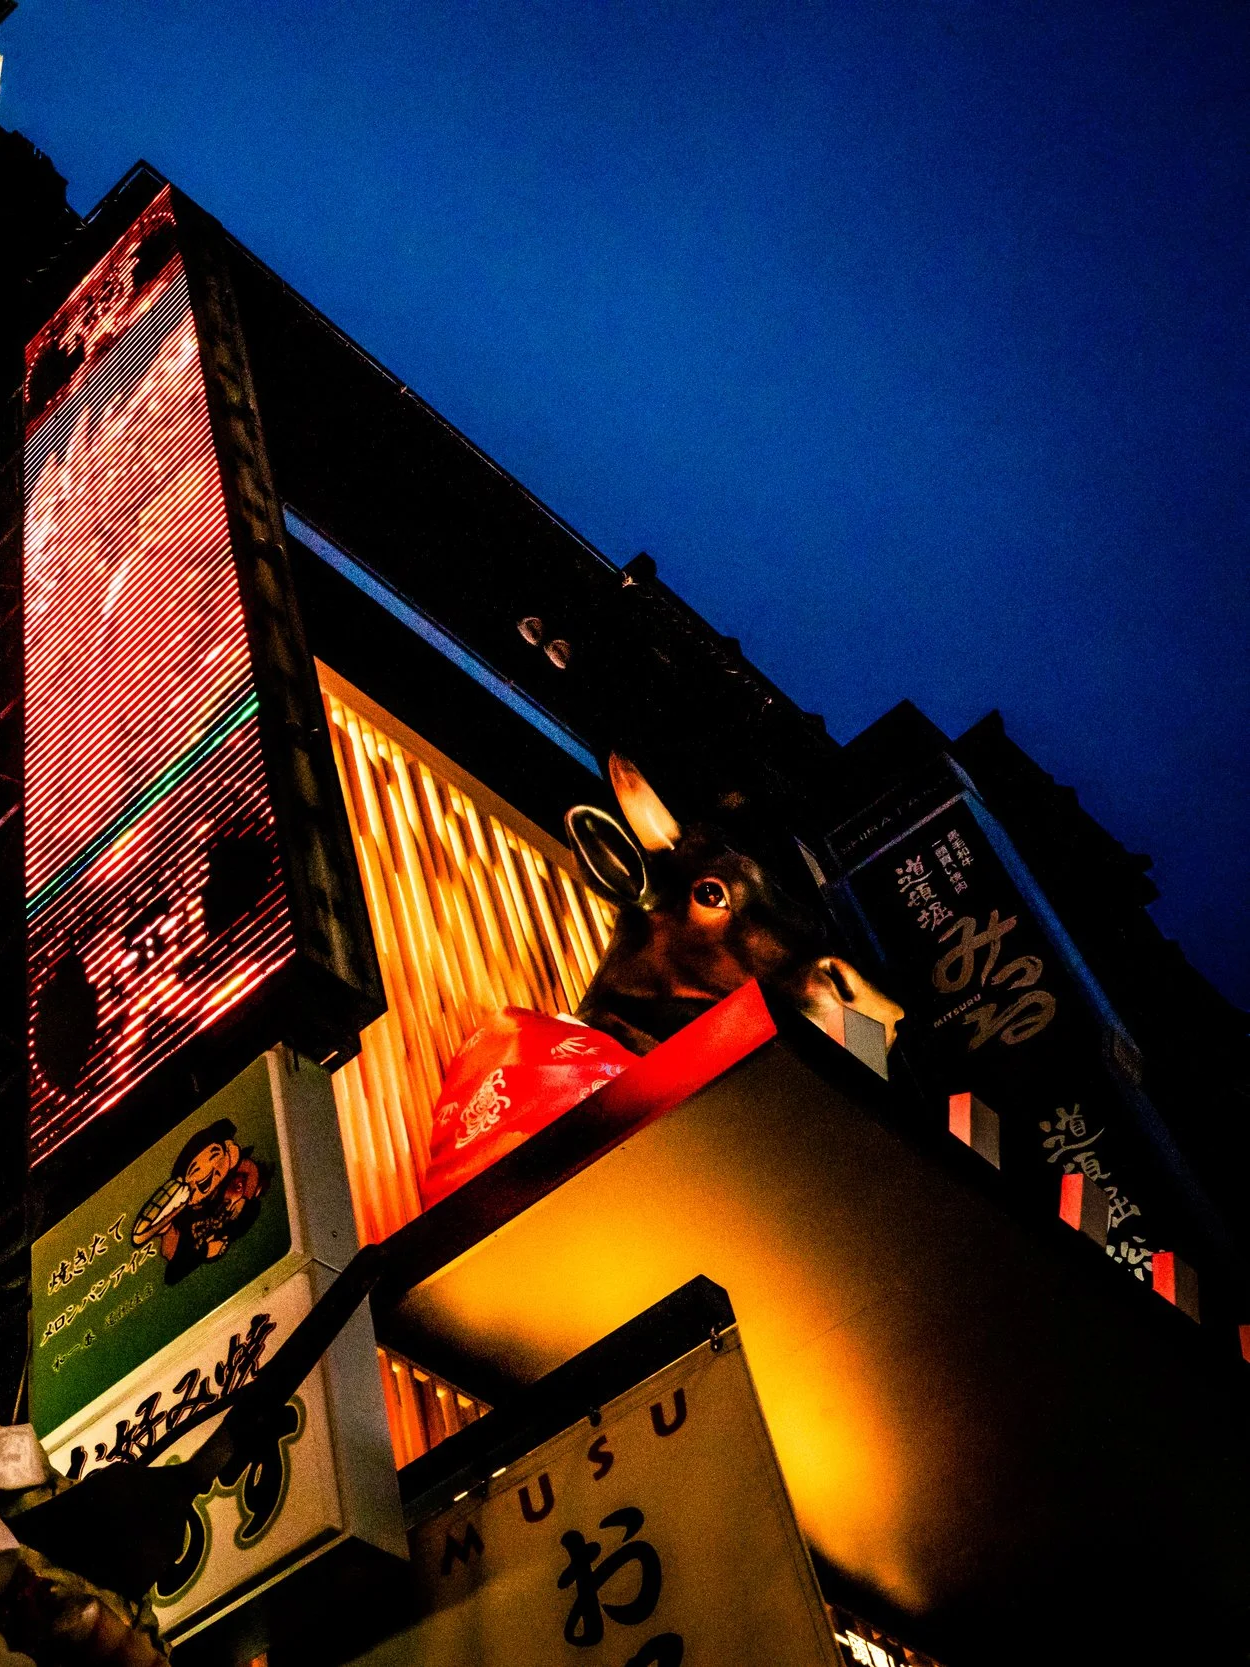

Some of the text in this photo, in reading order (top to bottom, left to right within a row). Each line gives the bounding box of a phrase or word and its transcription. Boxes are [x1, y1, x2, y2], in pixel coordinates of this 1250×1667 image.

[895, 854, 954, 932] 道頓堀
[931, 907, 1057, 1053] みつる
[933, 992, 982, 1029] MITSURU
[39, 1241, 158, 1348] メロンパンアイス
[47, 1213, 127, 1296] 焼きたて
[557, 1507, 684, 1667] お
